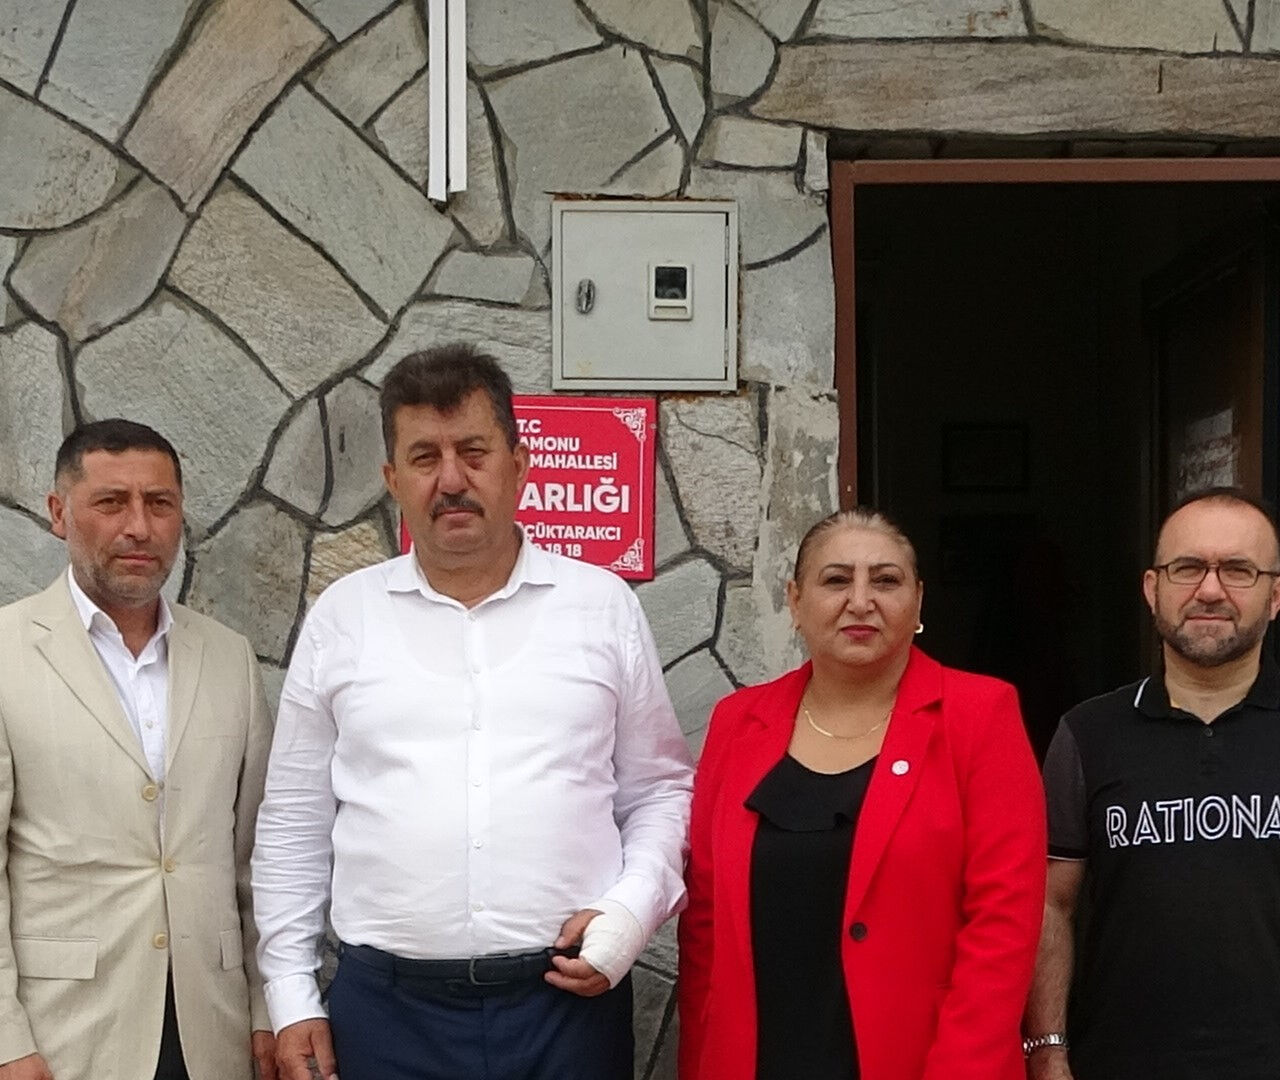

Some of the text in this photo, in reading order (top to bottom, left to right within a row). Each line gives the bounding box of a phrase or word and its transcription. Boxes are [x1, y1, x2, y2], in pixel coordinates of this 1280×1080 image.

[517, 419, 542, 434] T.C
[519, 436, 580, 452] AMONU
[529, 452, 618, 470] MAHALLESİ
[518, 476, 630, 513] ARLIĞI
[518, 521, 621, 540] ÇÜKTARAKCI
[565, 543, 582, 557] 18
